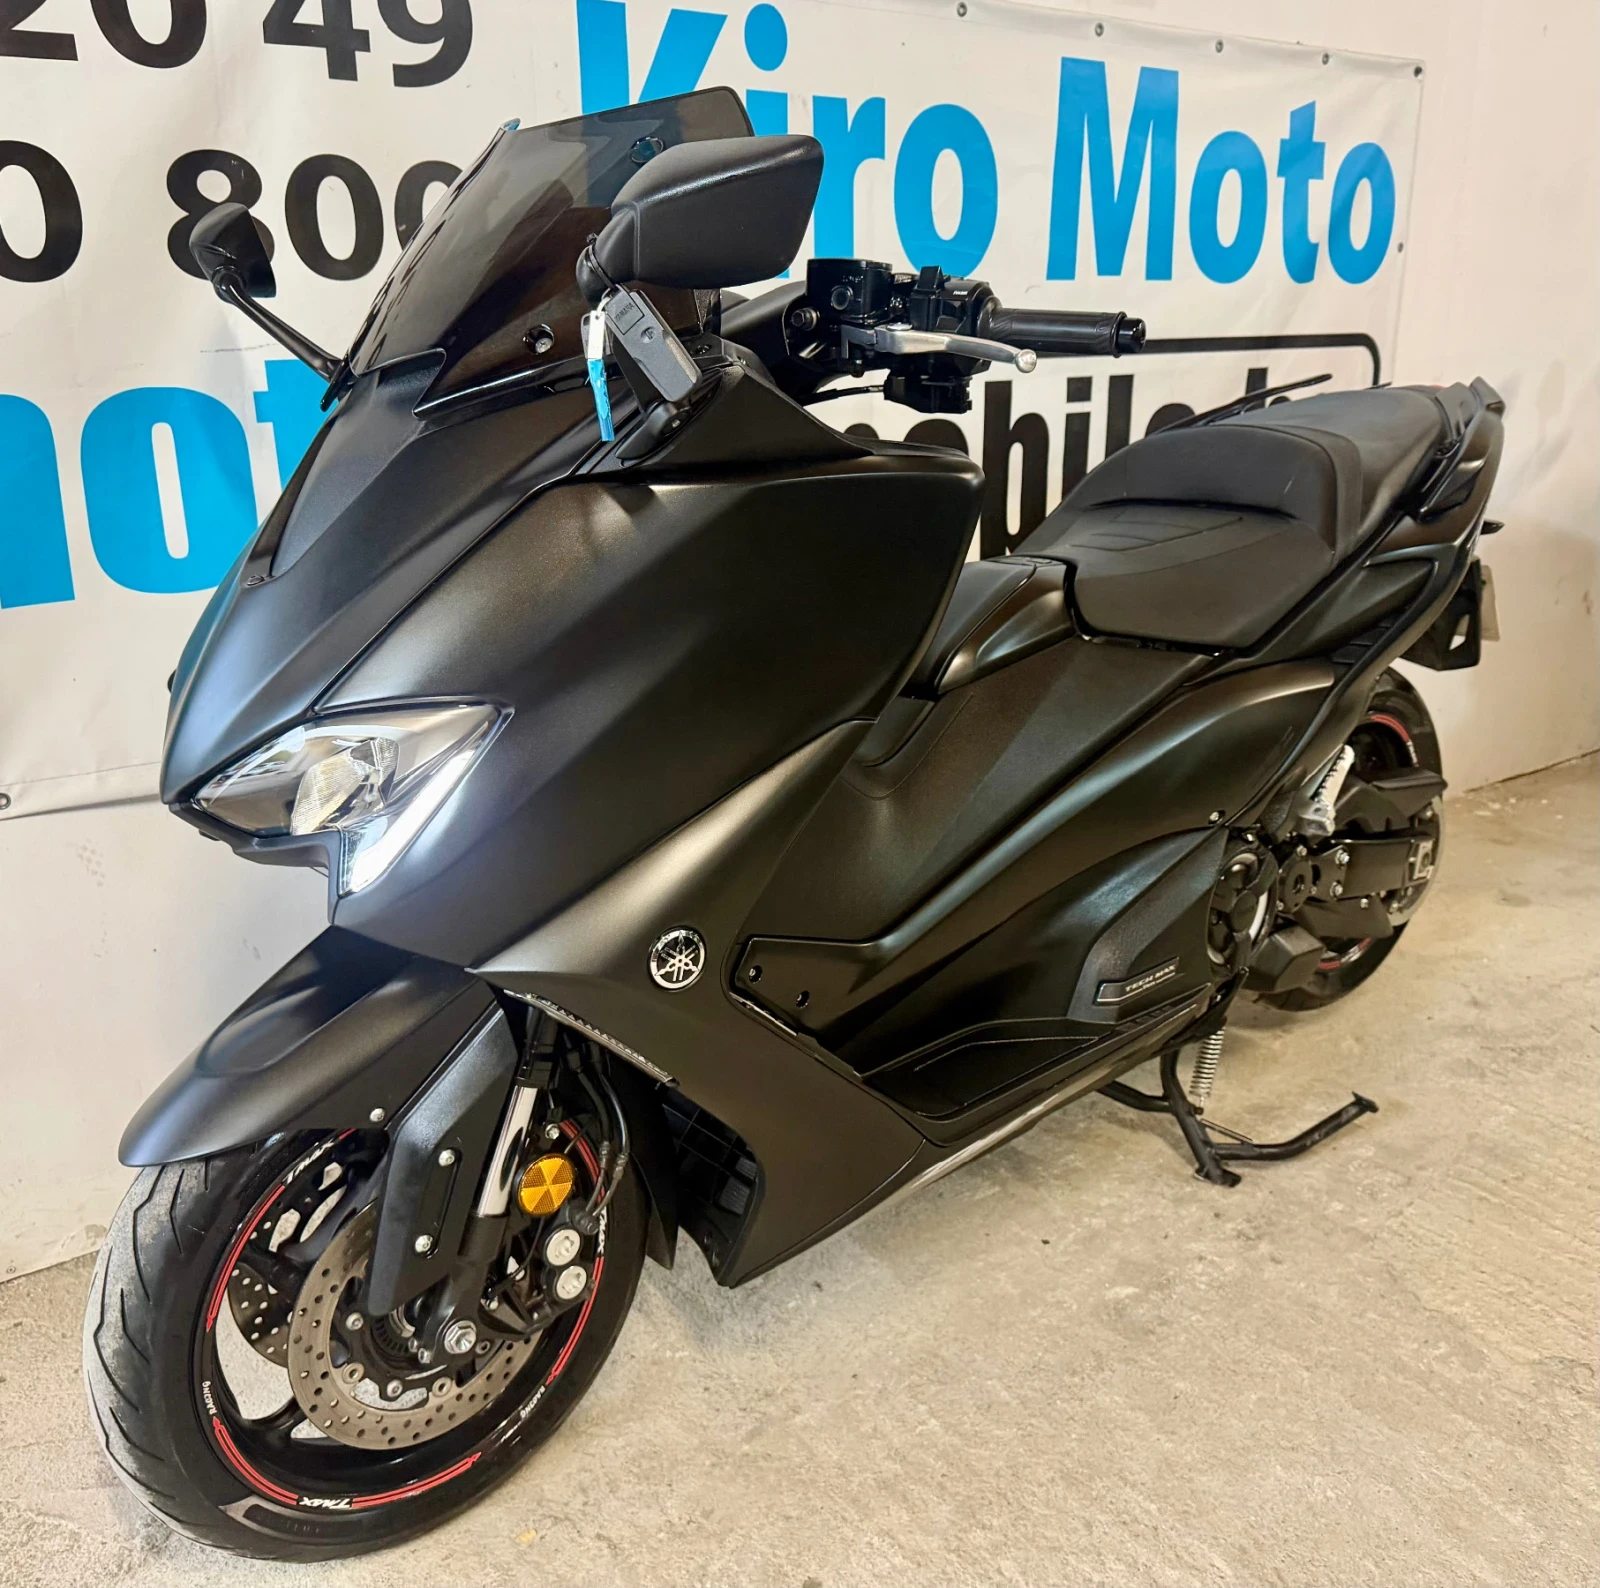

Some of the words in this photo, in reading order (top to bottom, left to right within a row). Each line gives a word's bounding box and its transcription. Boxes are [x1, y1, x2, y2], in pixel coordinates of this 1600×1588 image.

[262, 0, 473, 88] 49
[576, 0, 999, 282] Kiro
[1046, 57, 1396, 285] Moto
[201, 1380, 218, 1416] RACING
[298, 1496, 352, 1509] TMAX
